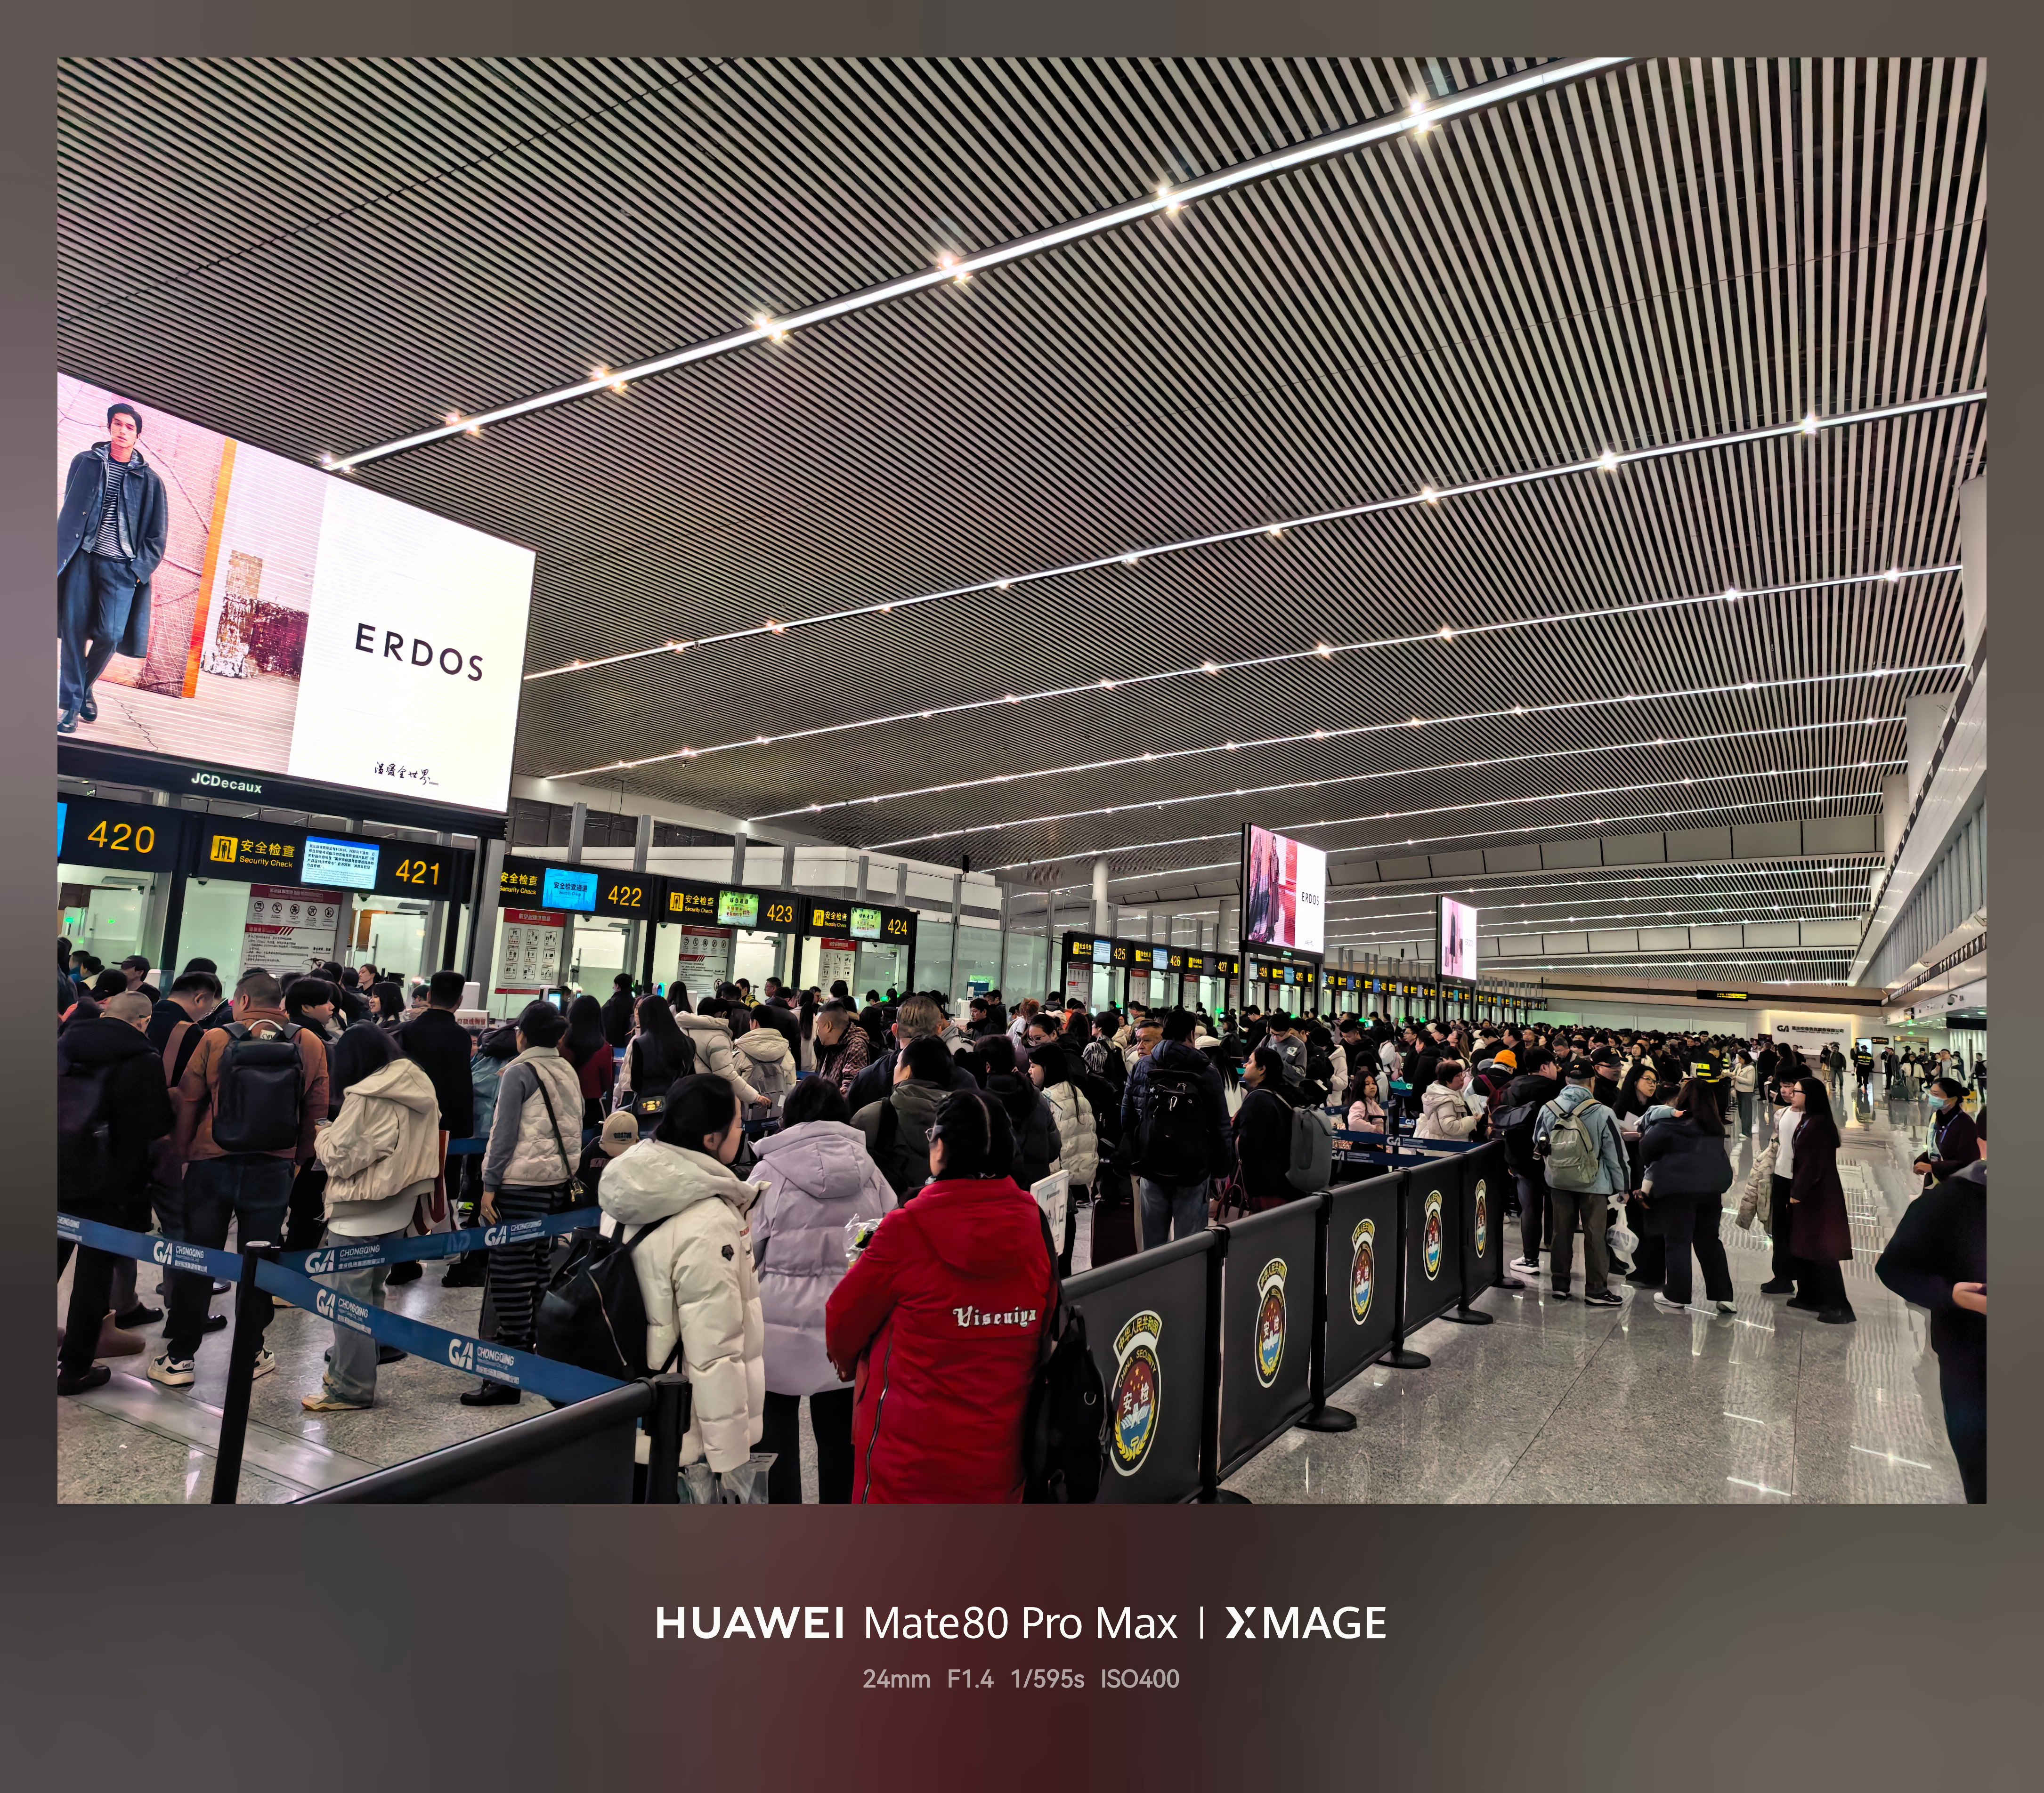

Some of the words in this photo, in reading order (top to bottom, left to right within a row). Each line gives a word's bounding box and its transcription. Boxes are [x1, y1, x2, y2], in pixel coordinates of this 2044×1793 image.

[356, 622, 483, 681] ERDOS
[191, 772, 262, 793] JCDecaux
[87, 821, 155, 853] 420
[240, 839, 295, 858] 安全检查
[239, 856, 269, 867] Security
[270, 859, 293, 868] Check
[395, 859, 439, 886] 421
[501, 872, 538, 886] 安全检查
[608, 885, 642, 907] 422
[685, 894, 714, 906] 安全检查
[1302, 892, 1319, 905] ERDOS
[766, 904, 793, 923] 423
[825, 911, 847, 921] 安全检查
[887, 919, 908, 935] 424
[1114, 948, 1126, 961] 425
[1170, 955, 1181, 967] 426
[1218, 961, 1227, 972] 427
[1259, 967, 1268, 977] 428
[176, 1245, 204, 1259] CHONGQING
[340, 1244, 381, 1258] CHONGQING
[1118, 1315, 1160, 1350] 中华人民共和国
[477, 1346, 514, 1366] CHONGQING
[1119, 1357, 1134, 1388] CHINA
[1136, 1349, 1157, 1375] SECURITY
